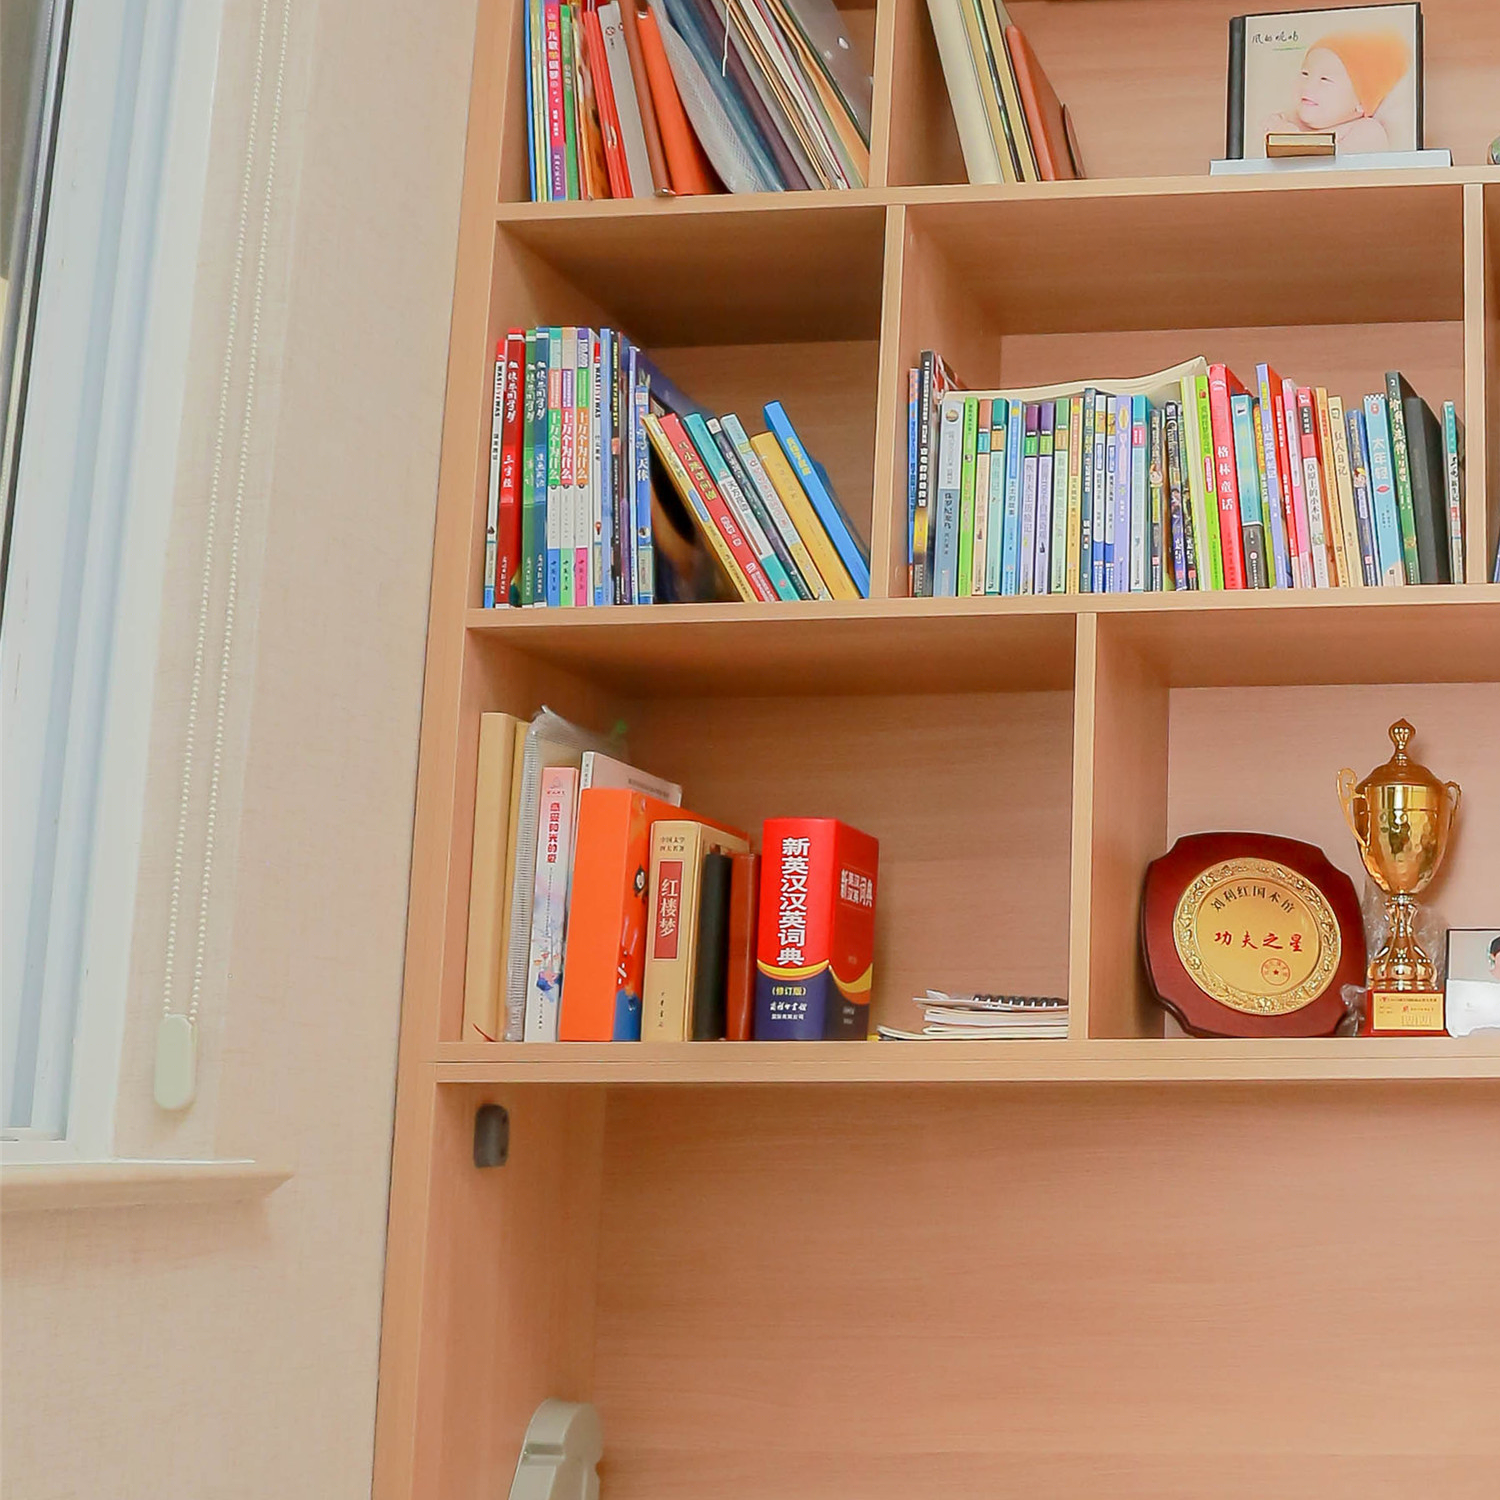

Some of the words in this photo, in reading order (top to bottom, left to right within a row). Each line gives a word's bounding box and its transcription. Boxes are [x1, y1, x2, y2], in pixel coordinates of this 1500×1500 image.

[550, 411, 560, 480] 十万个为什么
[561, 410, 573, 480] 十万个为什么
[577, 411, 588, 480] 十万个为什么
[1217, 445, 1234, 511] 格林童话
[660, 878, 679, 937] 红楼梦
[776, 837, 811, 967] 新英汉汉英词典
[1213, 930, 1304, 953] 功夫之星
